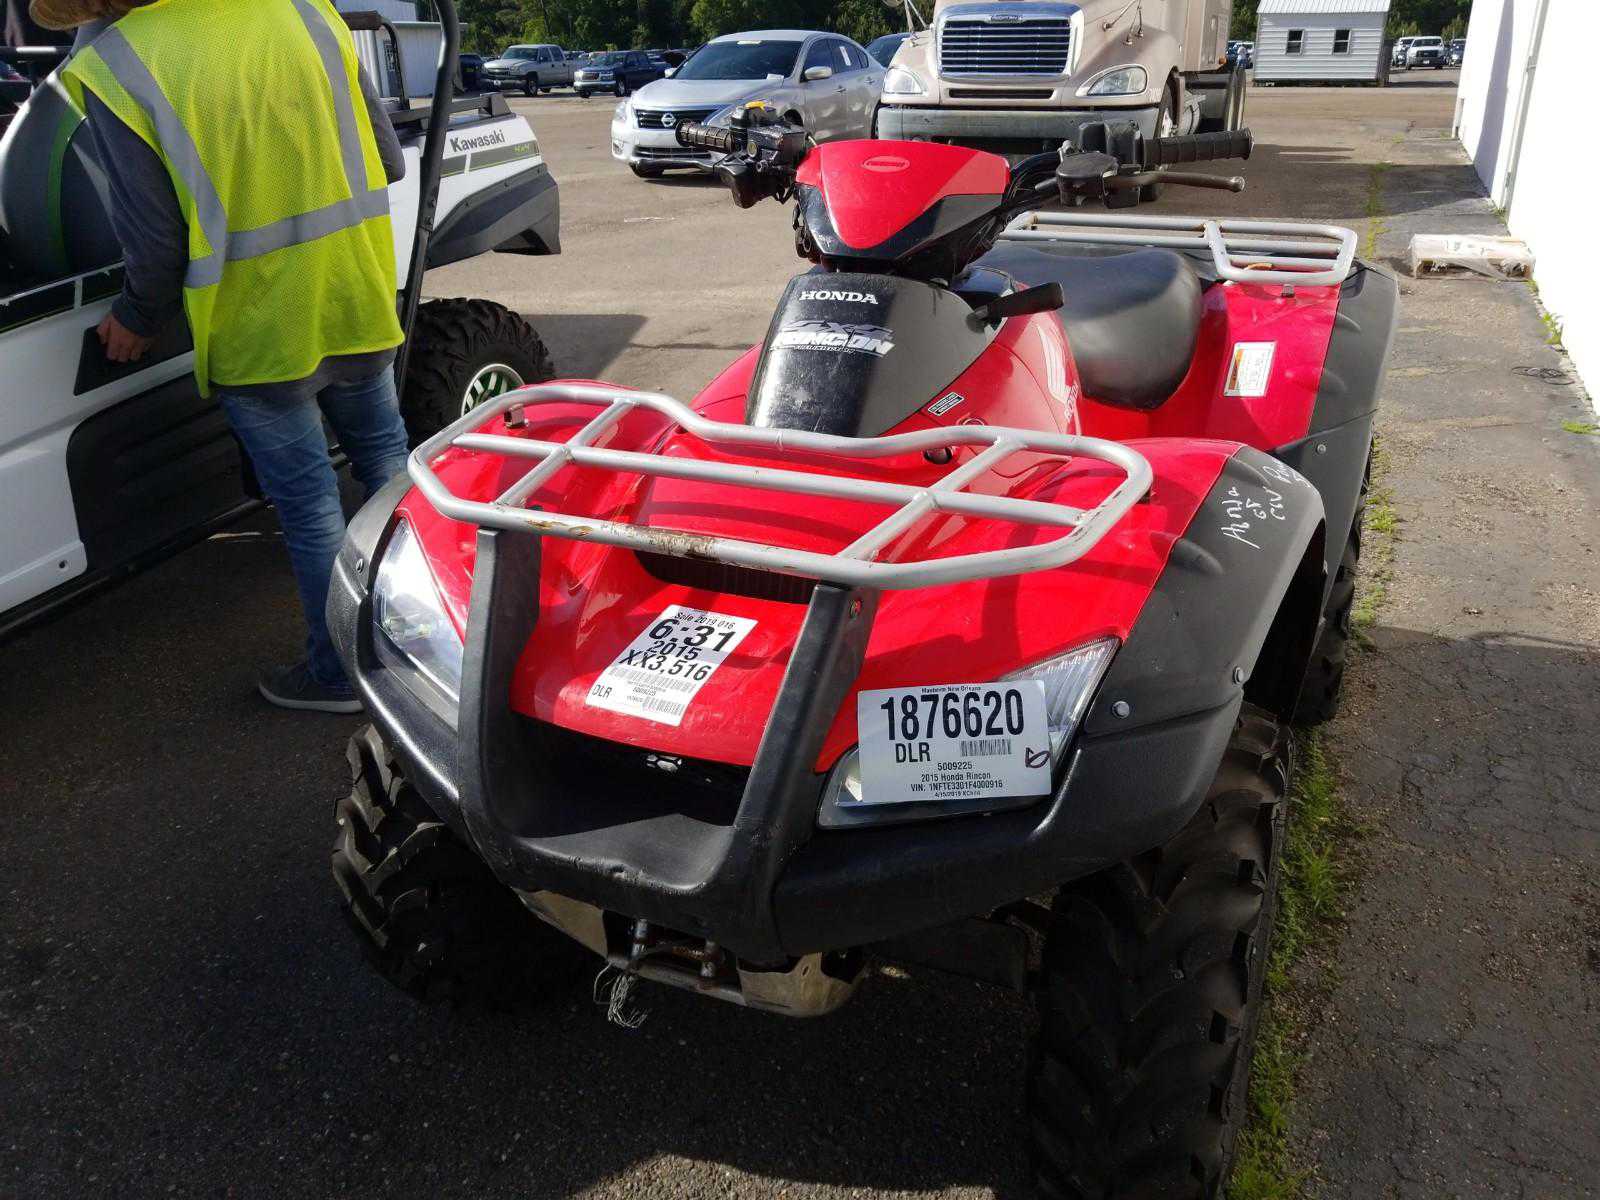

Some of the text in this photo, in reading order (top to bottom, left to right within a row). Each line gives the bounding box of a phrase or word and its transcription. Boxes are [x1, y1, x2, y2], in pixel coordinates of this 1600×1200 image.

[450, 129, 505, 152] Kawasaki
[799, 290, 879, 305] HONDA
[694, 616, 715, 626] 2019
[648, 618, 736, 652] 6:31
[648, 640, 702, 661] 2015
[591, 684, 613, 699] DLR
[881, 689, 1024, 741] 1876620
[895, 742, 931, 764] DLR
[937, 762, 973, 771] 5009225
[921, 771, 991, 782] 2015 Honda Rincon
[910, 783, 926, 792] VIN:
